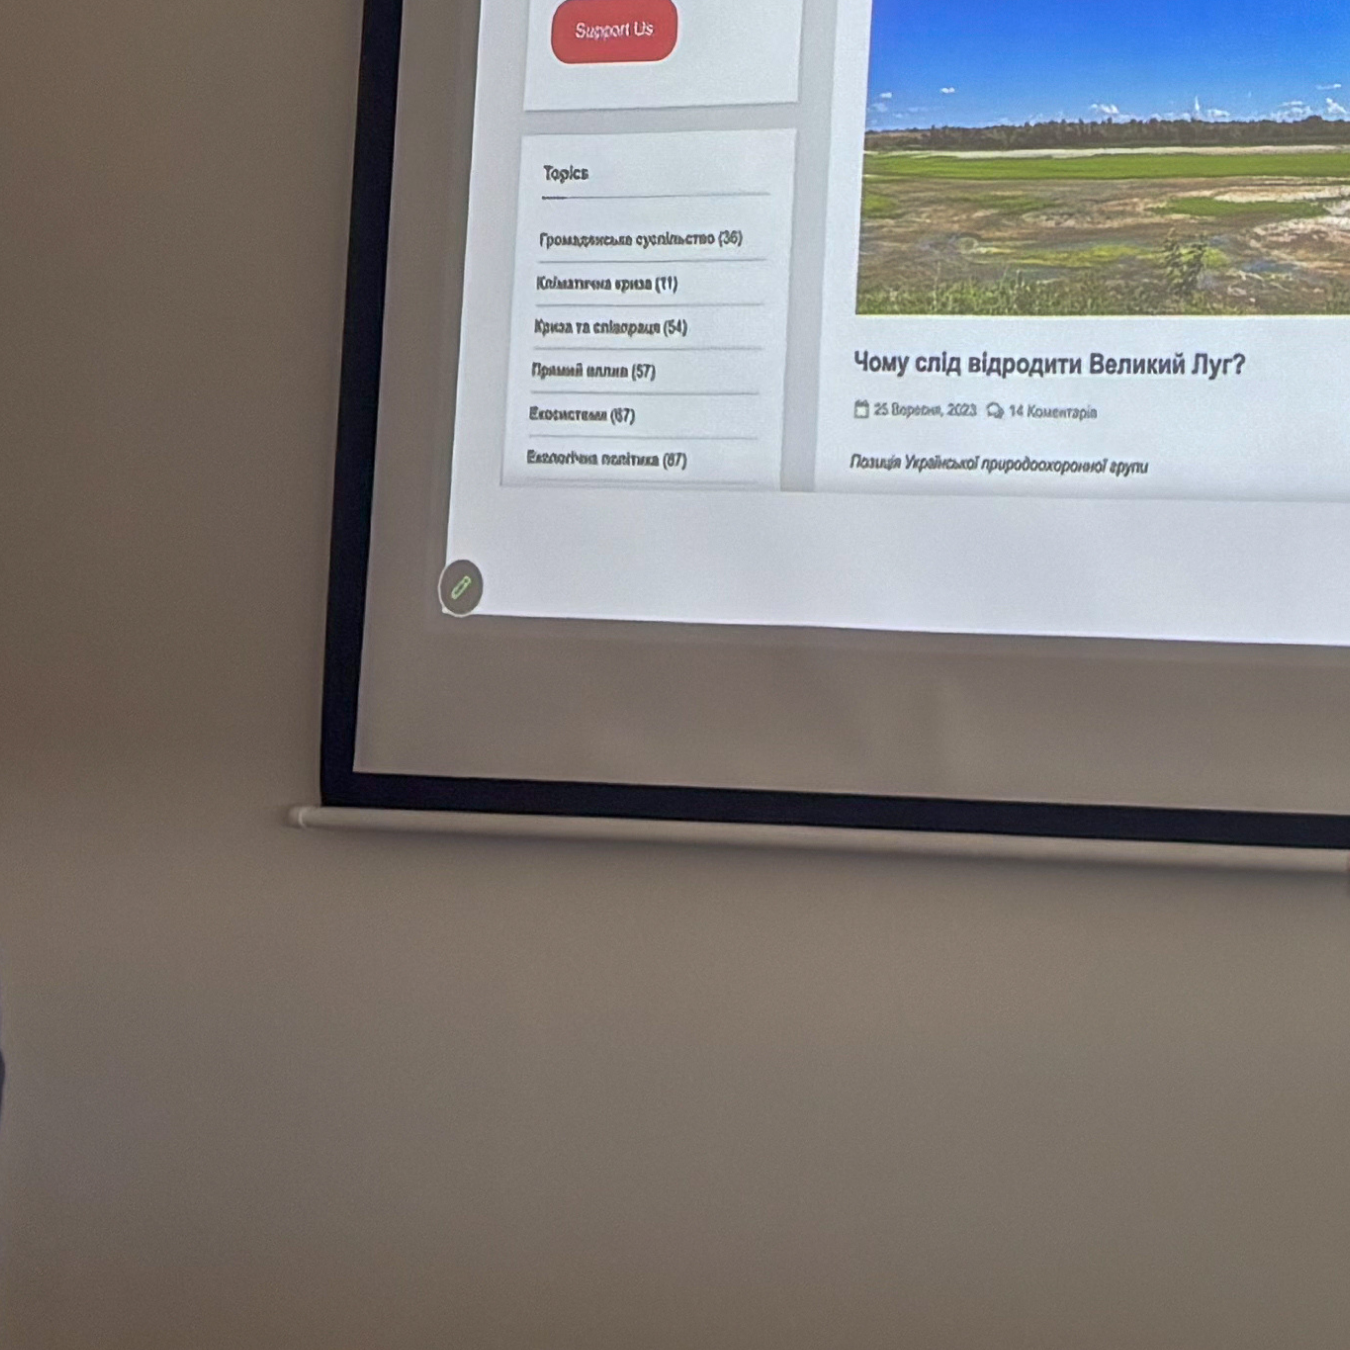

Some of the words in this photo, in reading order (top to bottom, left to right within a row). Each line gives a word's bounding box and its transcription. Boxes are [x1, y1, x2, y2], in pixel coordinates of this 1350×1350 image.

[575, 22, 630, 41] Support
[634, 22, 654, 36] Us
[544, 165, 589, 184] Topics
[854, 350, 909, 377] Чому
[915, 351, 961, 377] слід
[967, 352, 1082, 378] відродити
[1089, 353, 1185, 376] Великий
[1191, 353, 1246, 380] Луг?
